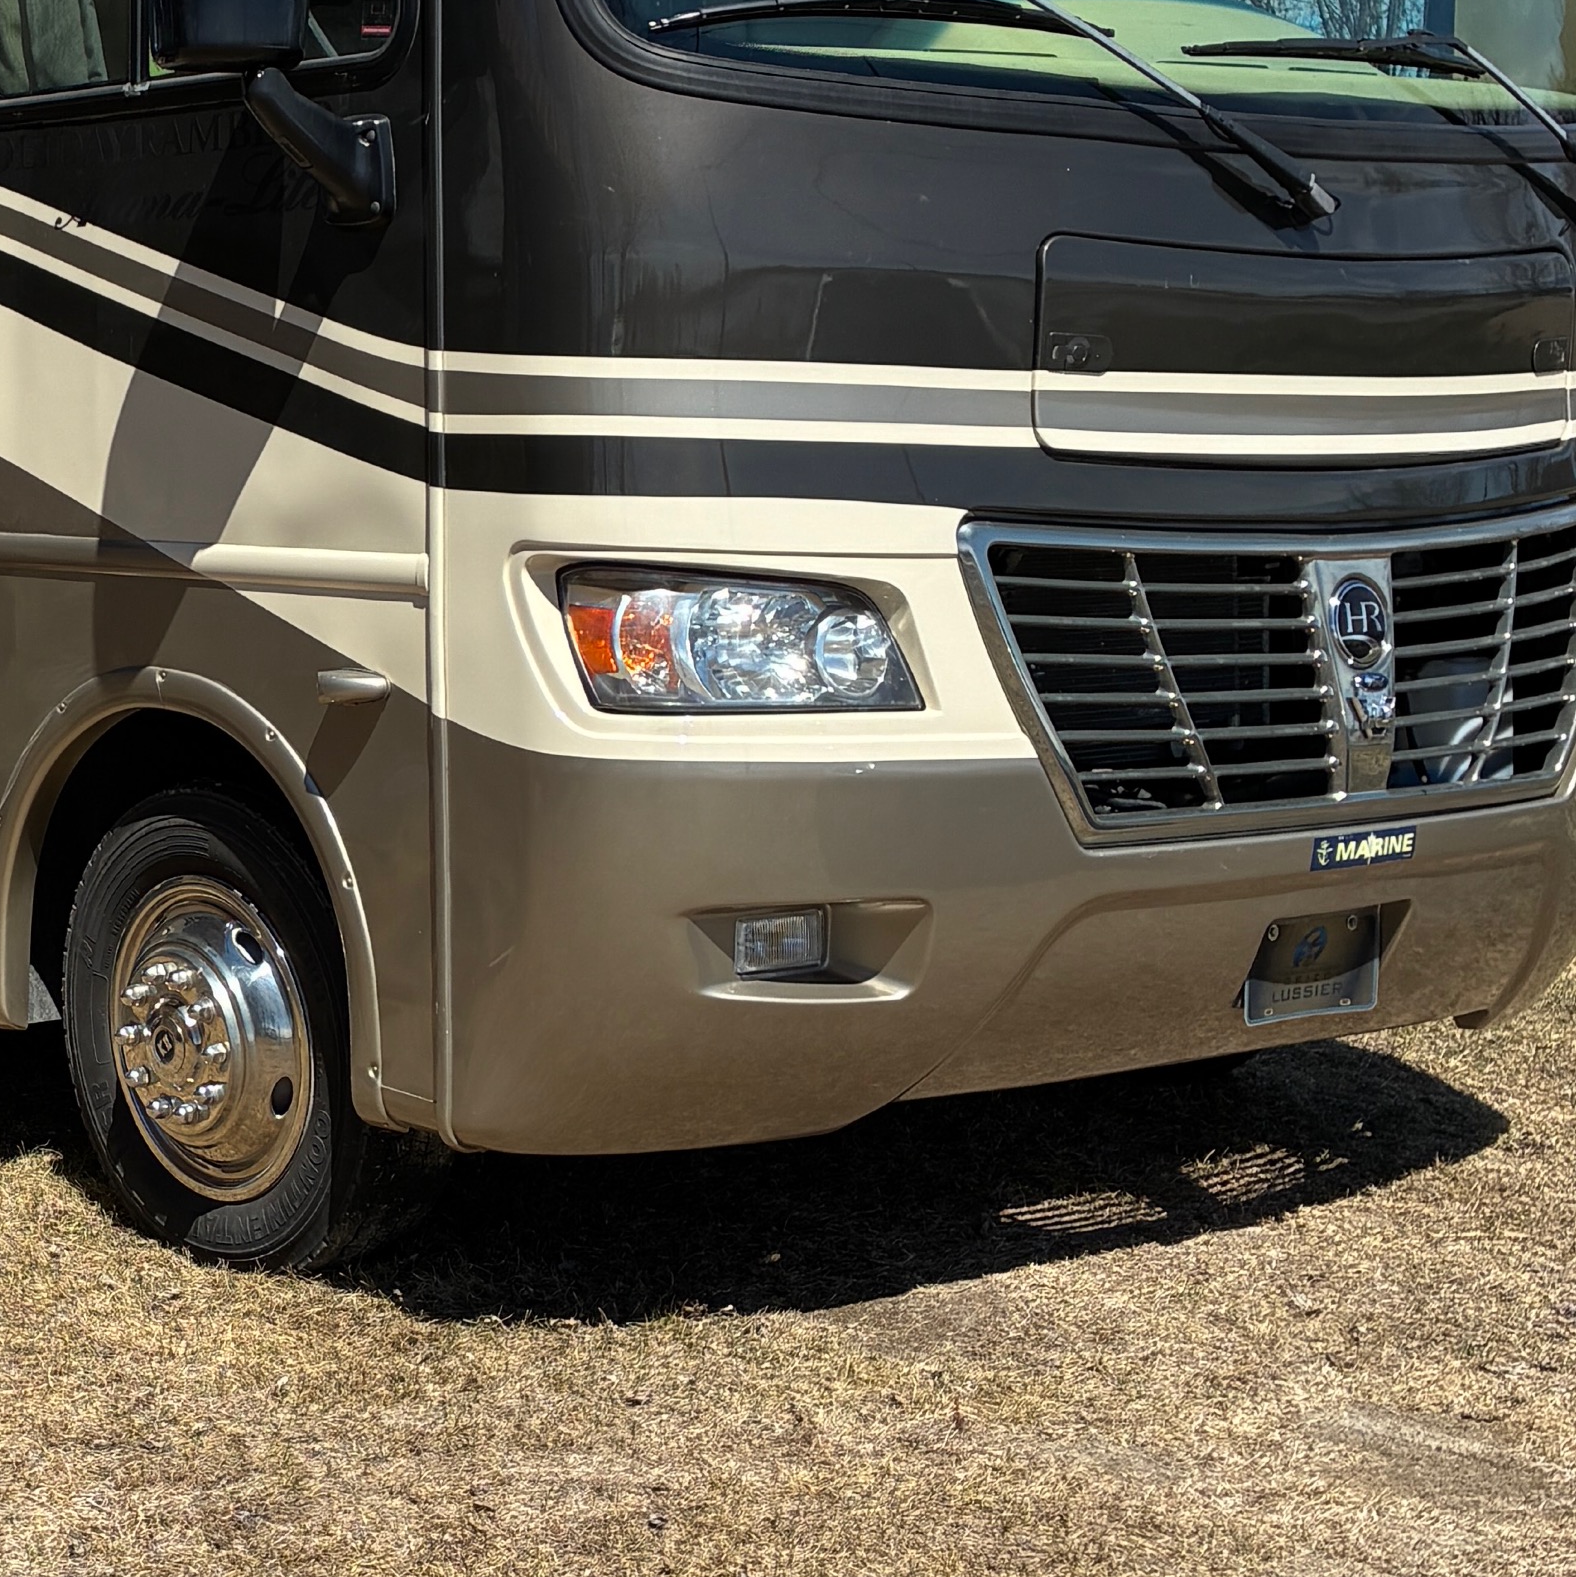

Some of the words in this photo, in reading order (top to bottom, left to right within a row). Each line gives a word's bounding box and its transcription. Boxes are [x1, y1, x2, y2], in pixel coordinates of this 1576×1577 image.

[1344, 601, 1383, 634] HR
[1335, 832, 1415, 862] MARINE
[1272, 981, 1343, 1003] LUSSIER
